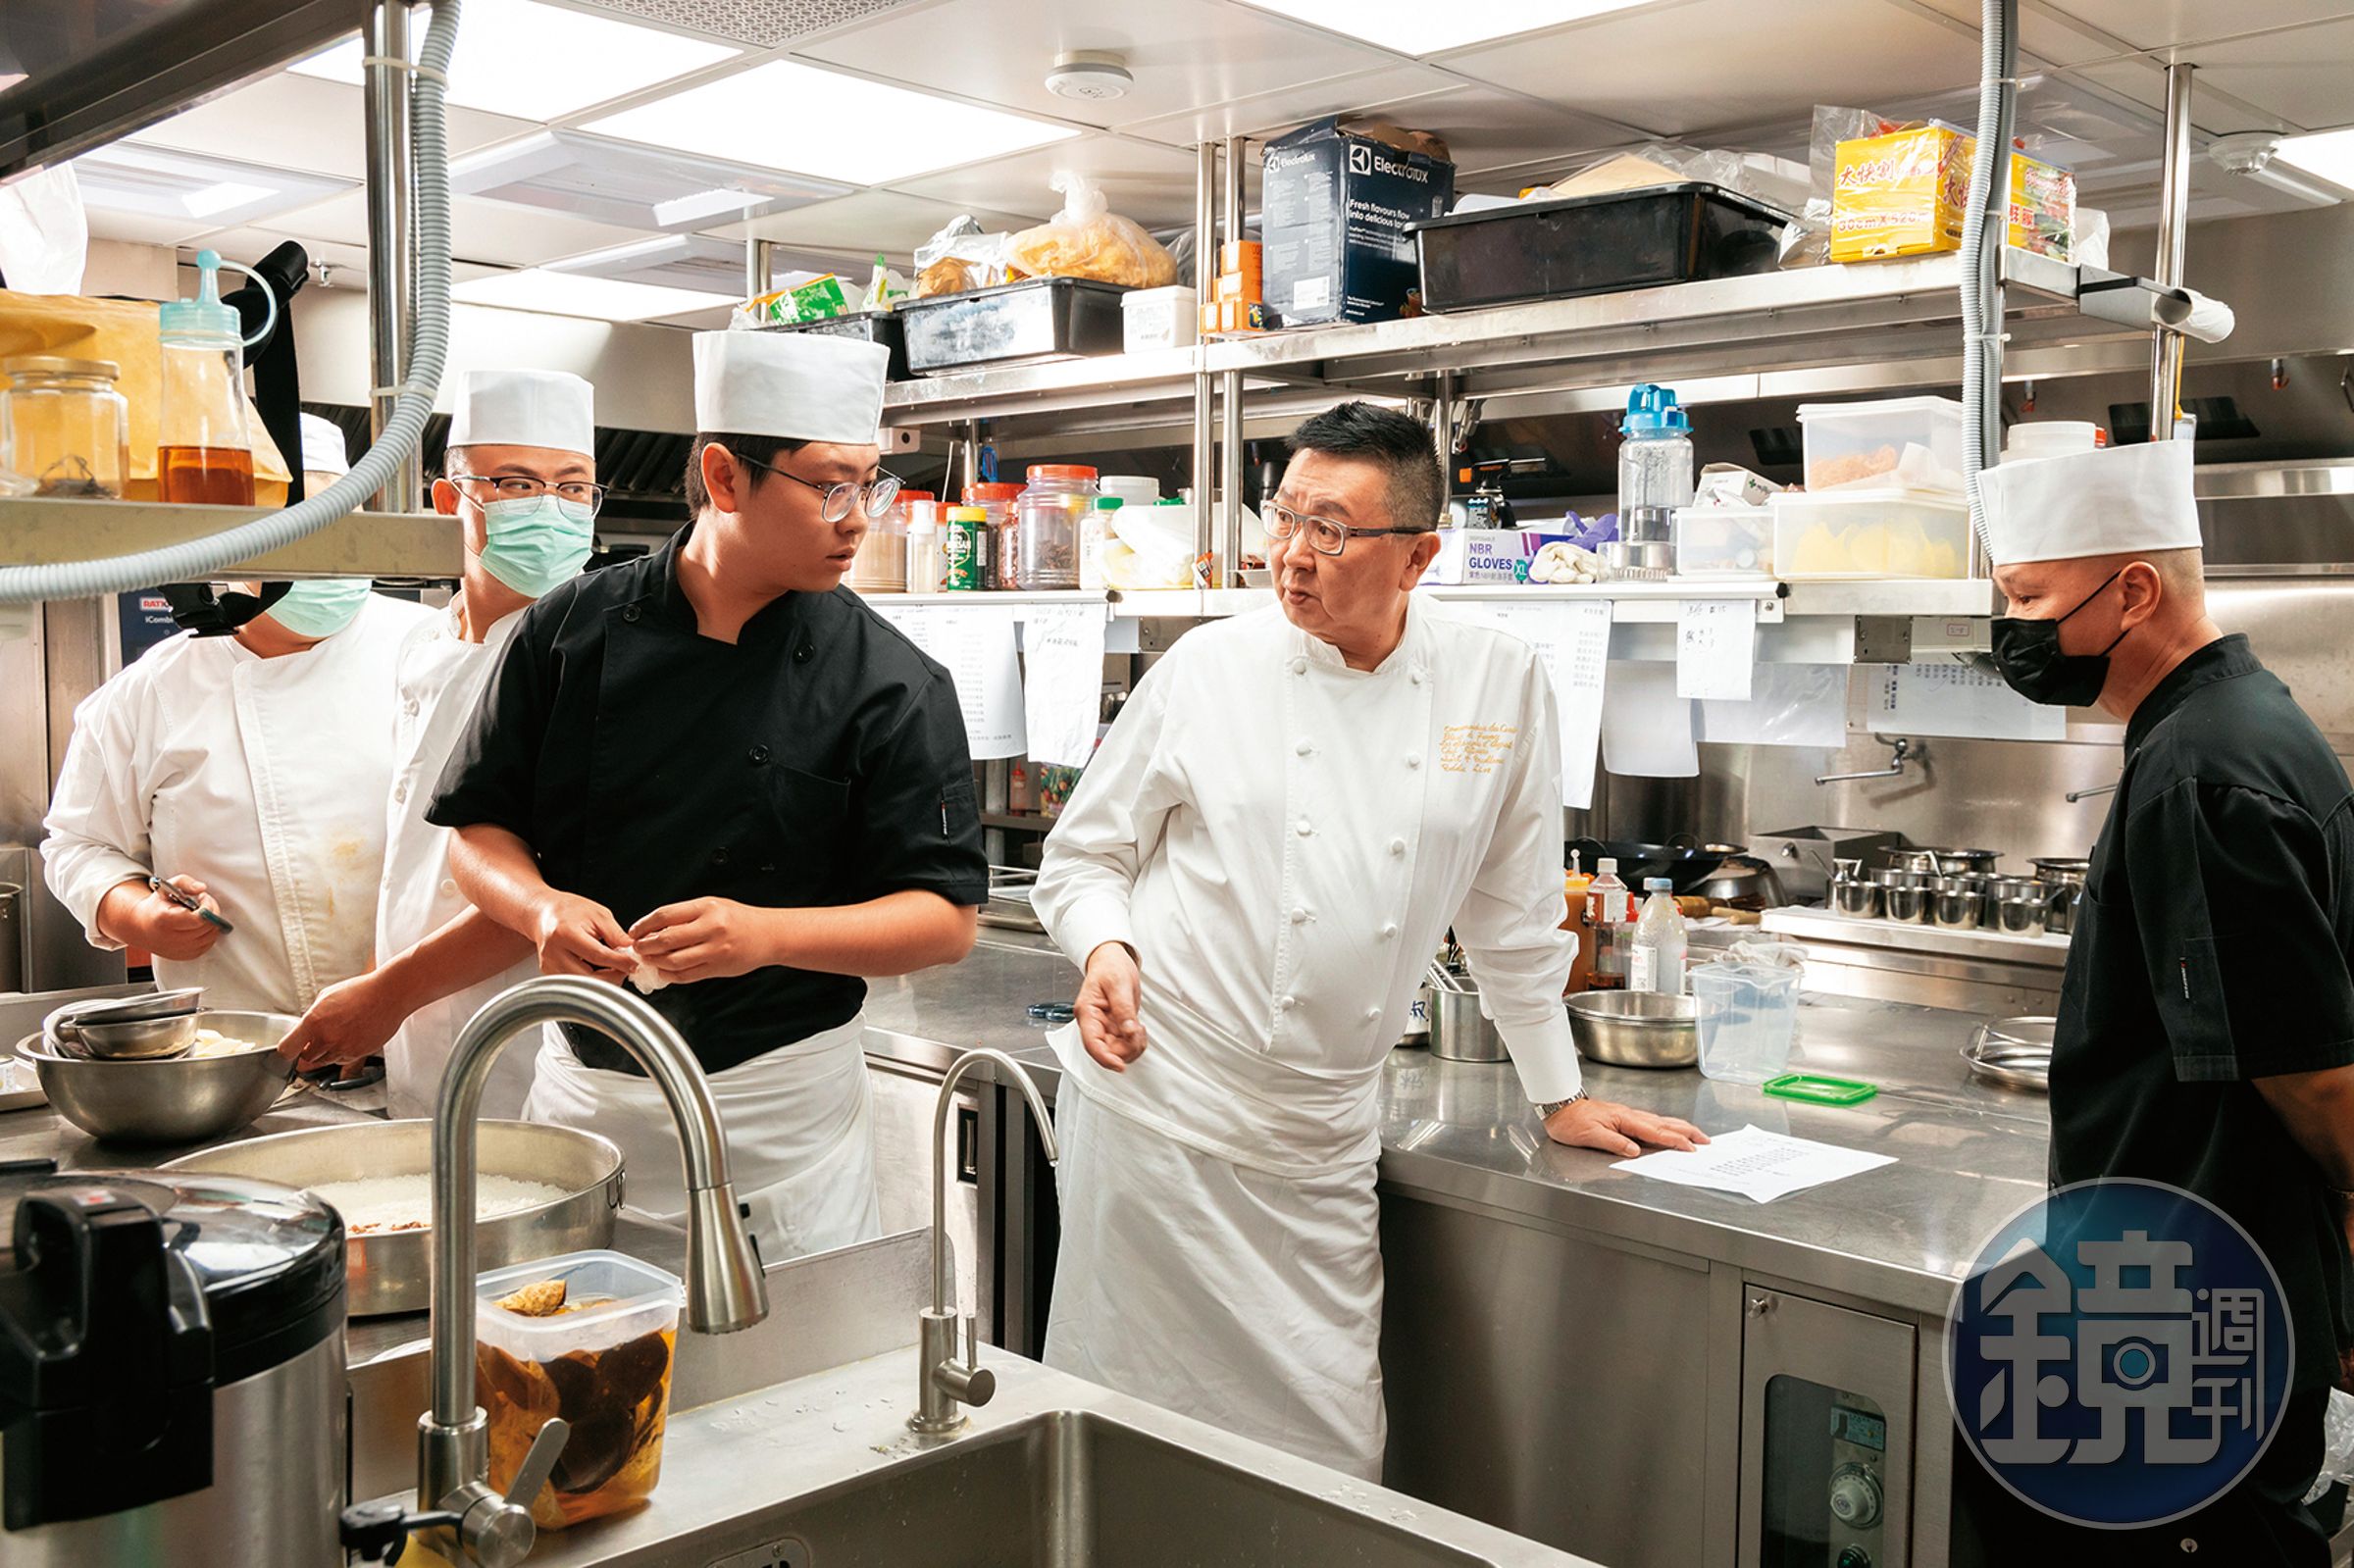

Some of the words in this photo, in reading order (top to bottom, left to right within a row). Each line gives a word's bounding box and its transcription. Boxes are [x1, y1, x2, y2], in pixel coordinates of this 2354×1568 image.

[1374, 156, 1428, 183] Electrolux
[1469, 543, 1492, 555] NBR
[1469, 557, 1512, 570] GLOVES
[1515, 564, 1527, 576] XL
